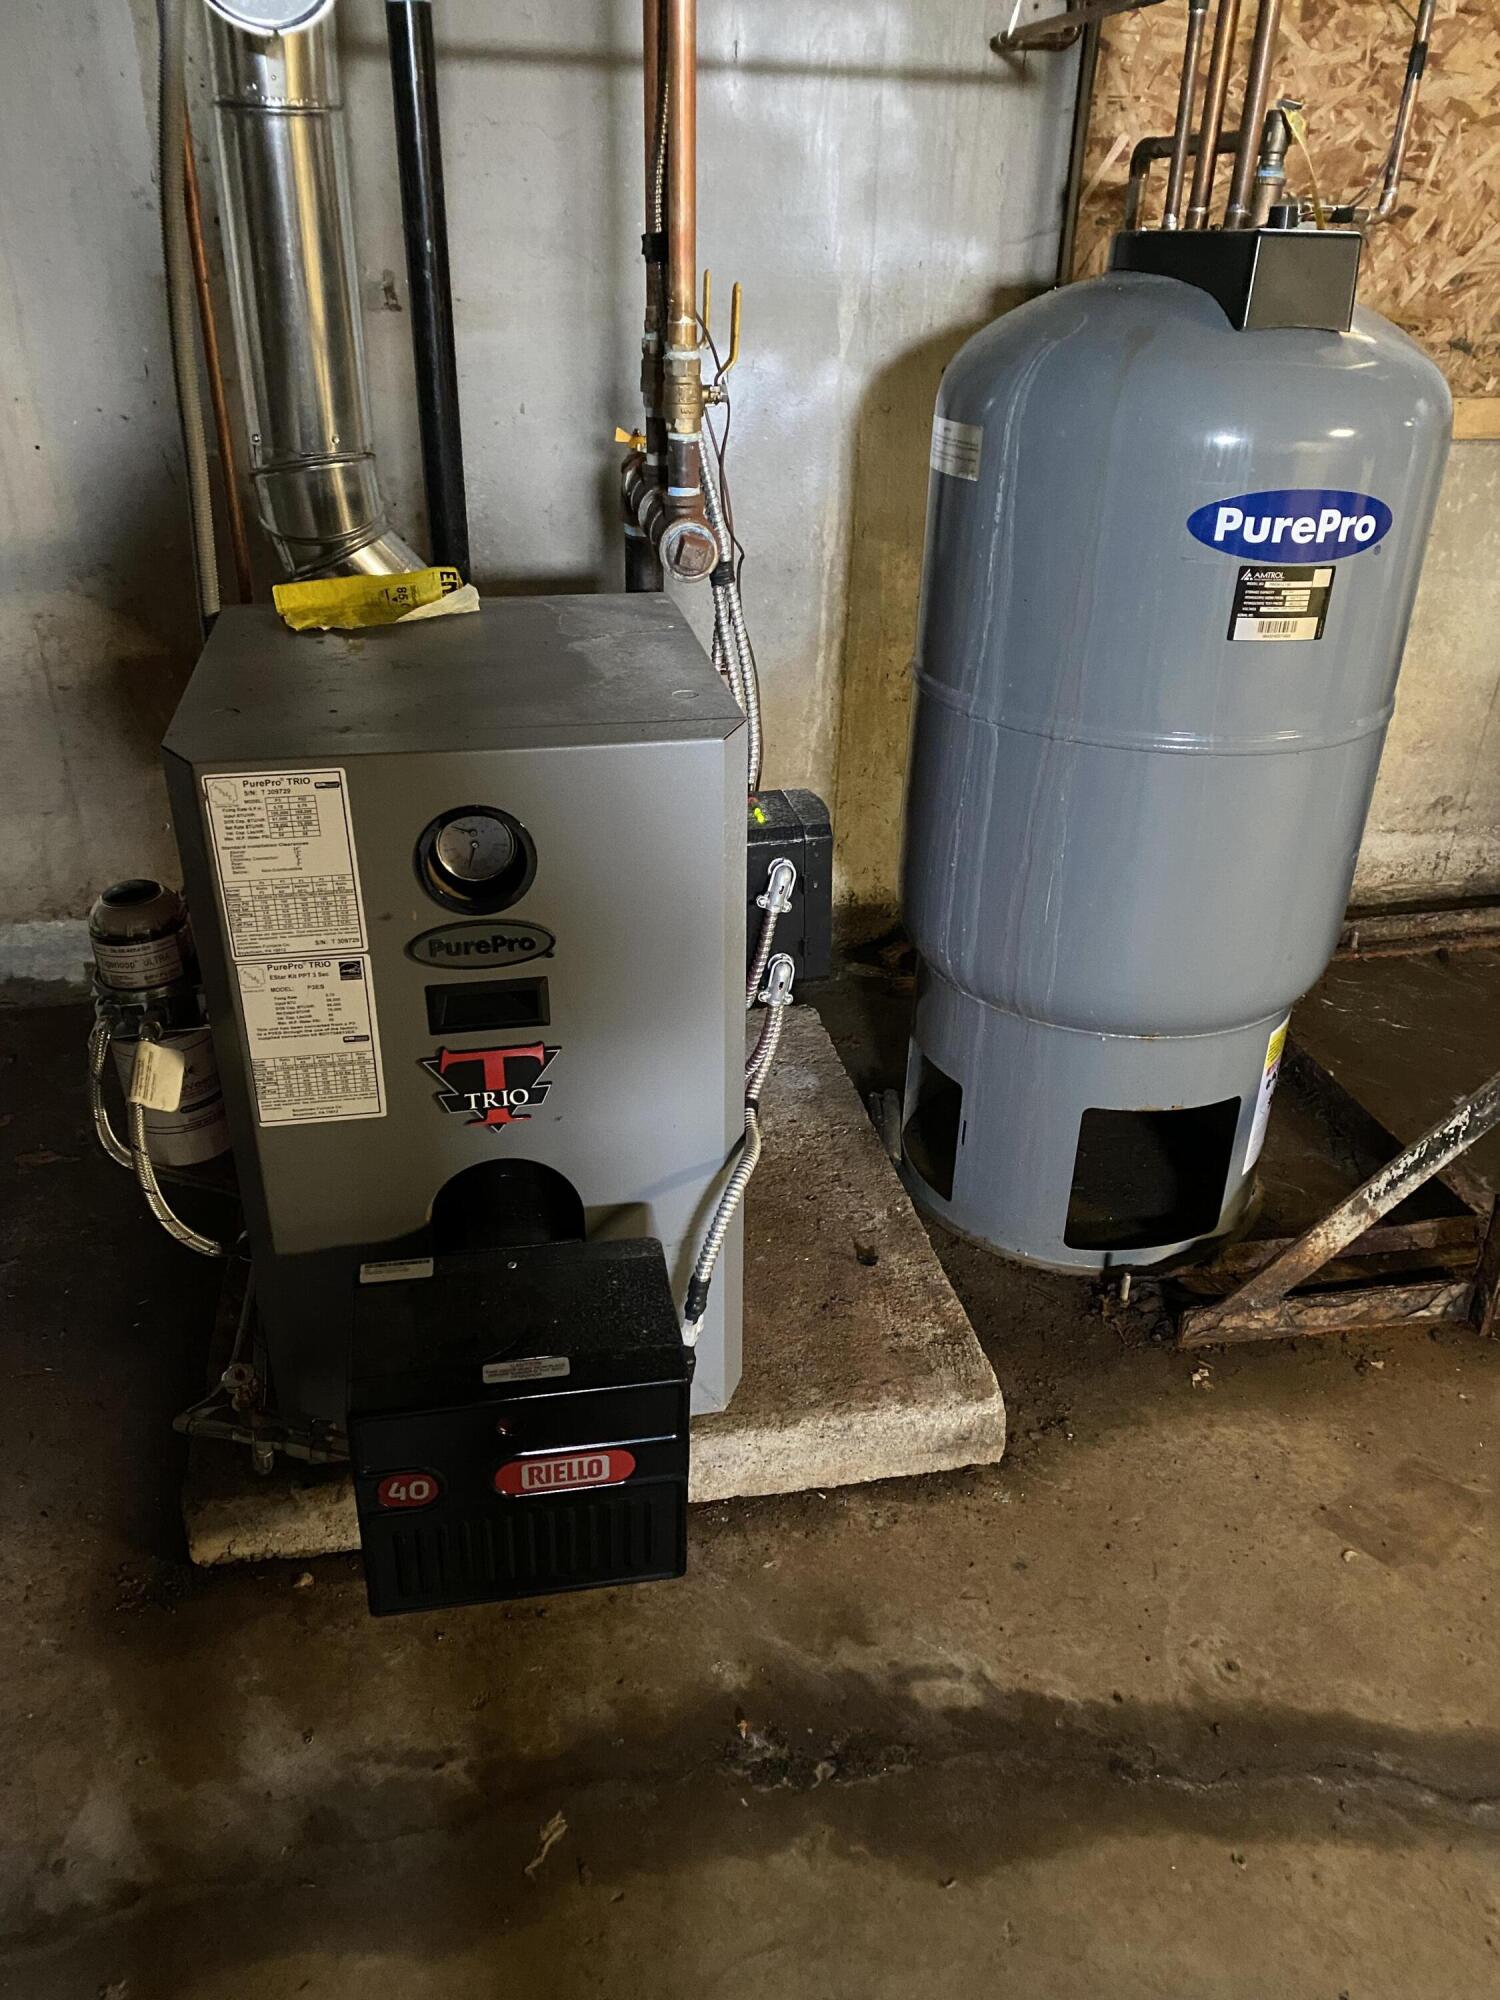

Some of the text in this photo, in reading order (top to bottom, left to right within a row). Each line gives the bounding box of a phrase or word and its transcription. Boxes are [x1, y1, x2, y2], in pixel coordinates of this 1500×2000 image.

[1214, 507, 1376, 544] PurePro
[242, 779, 281, 788] PurePro
[287, 778, 310, 786] TRIO
[428, 934, 536, 957] PurePro
[267, 963, 303, 971] PurePro
[464, 1088, 529, 1109] TRIO
[528, 1459, 602, 1486] RIELLO
[388, 1480, 429, 1501] 40
